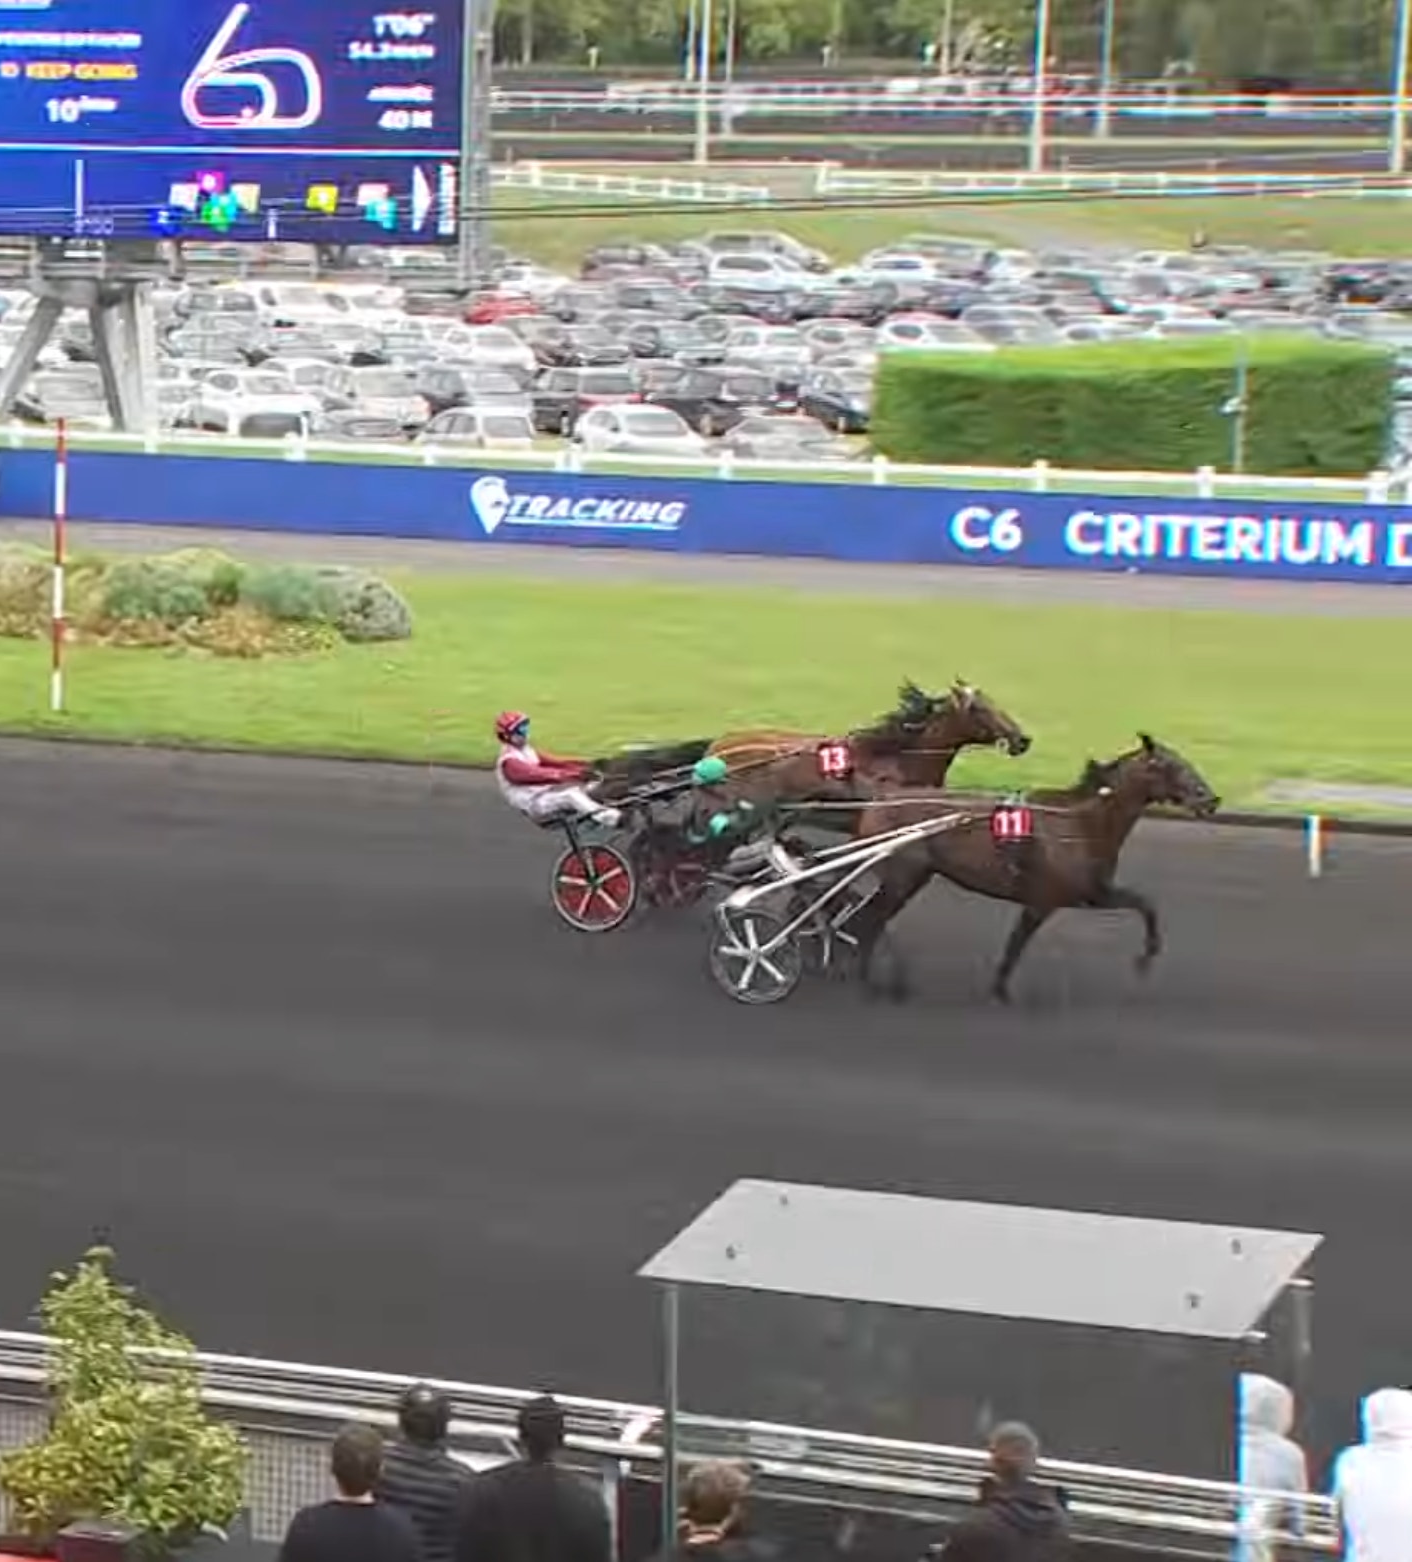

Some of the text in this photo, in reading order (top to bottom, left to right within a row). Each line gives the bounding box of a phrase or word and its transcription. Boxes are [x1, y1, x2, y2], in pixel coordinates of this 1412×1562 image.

[949, 507, 1023, 551] C6
[1064, 511, 1373, 565] CRITERIUM
[819, 746, 847, 772] 13
[997, 811, 1022, 835] 11
